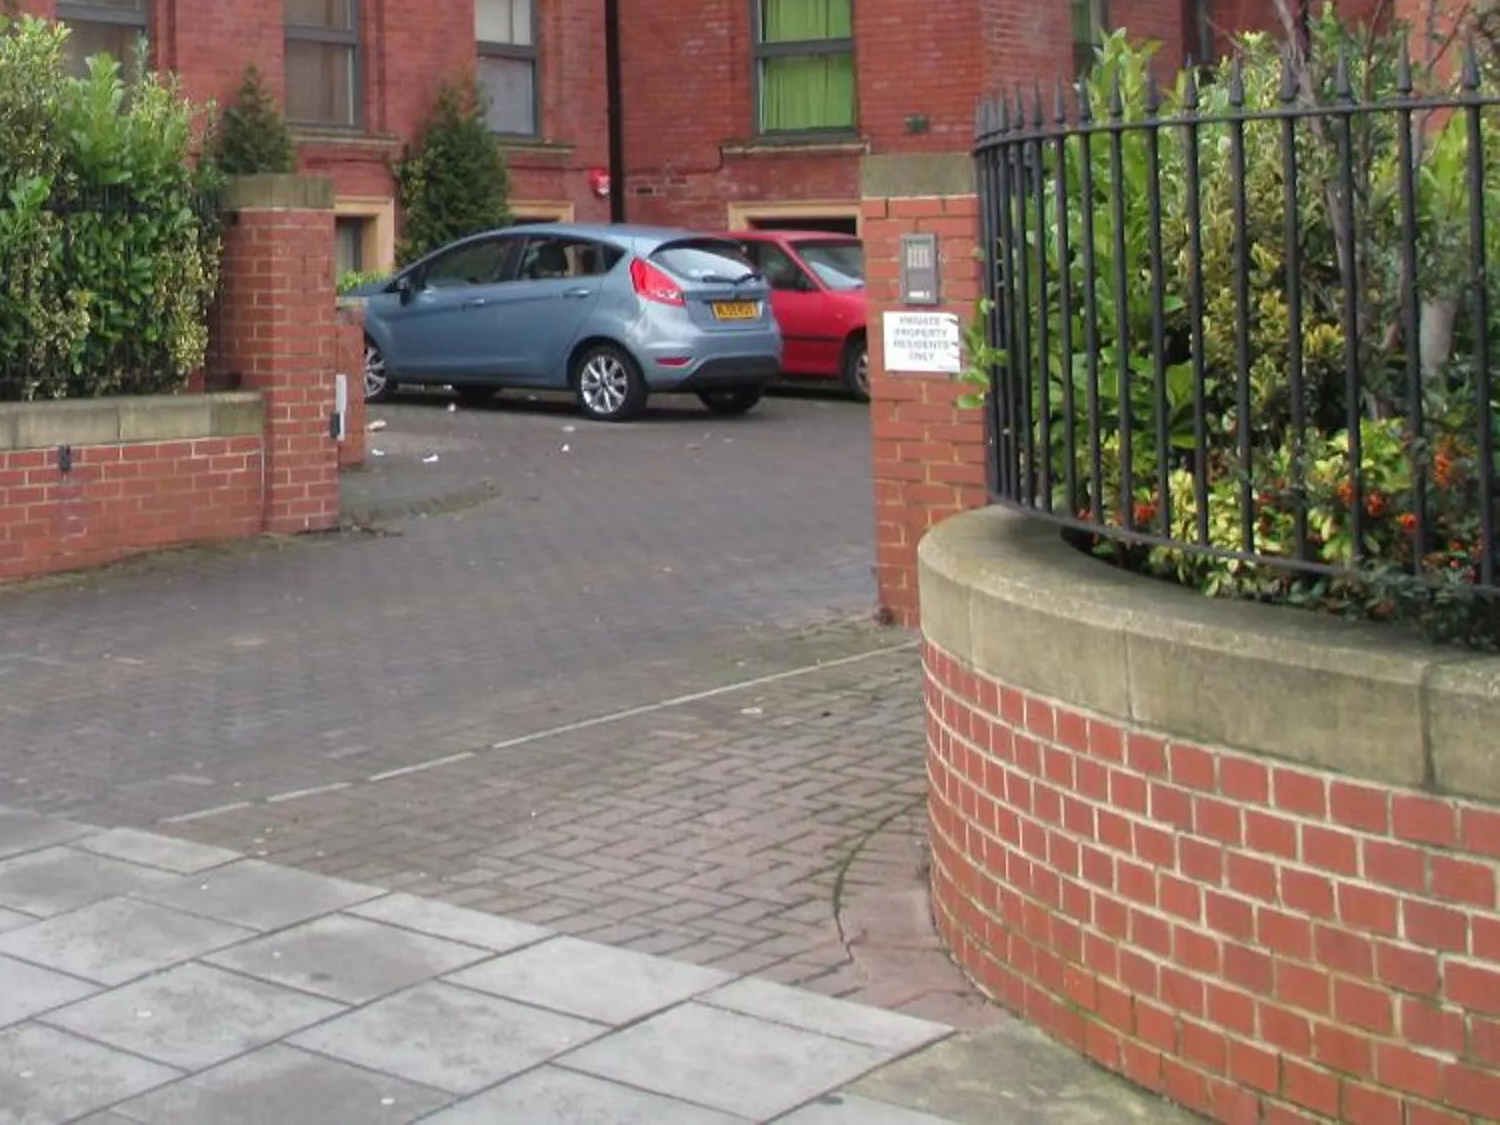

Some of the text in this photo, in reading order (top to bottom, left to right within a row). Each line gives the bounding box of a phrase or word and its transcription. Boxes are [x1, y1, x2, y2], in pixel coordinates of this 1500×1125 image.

[899, 316, 941, 325] PRIVATE
[894, 328, 948, 337] PROPERTY
[893, 340, 950, 349] RESIDENTS
[908, 352, 934, 361] ONLY
